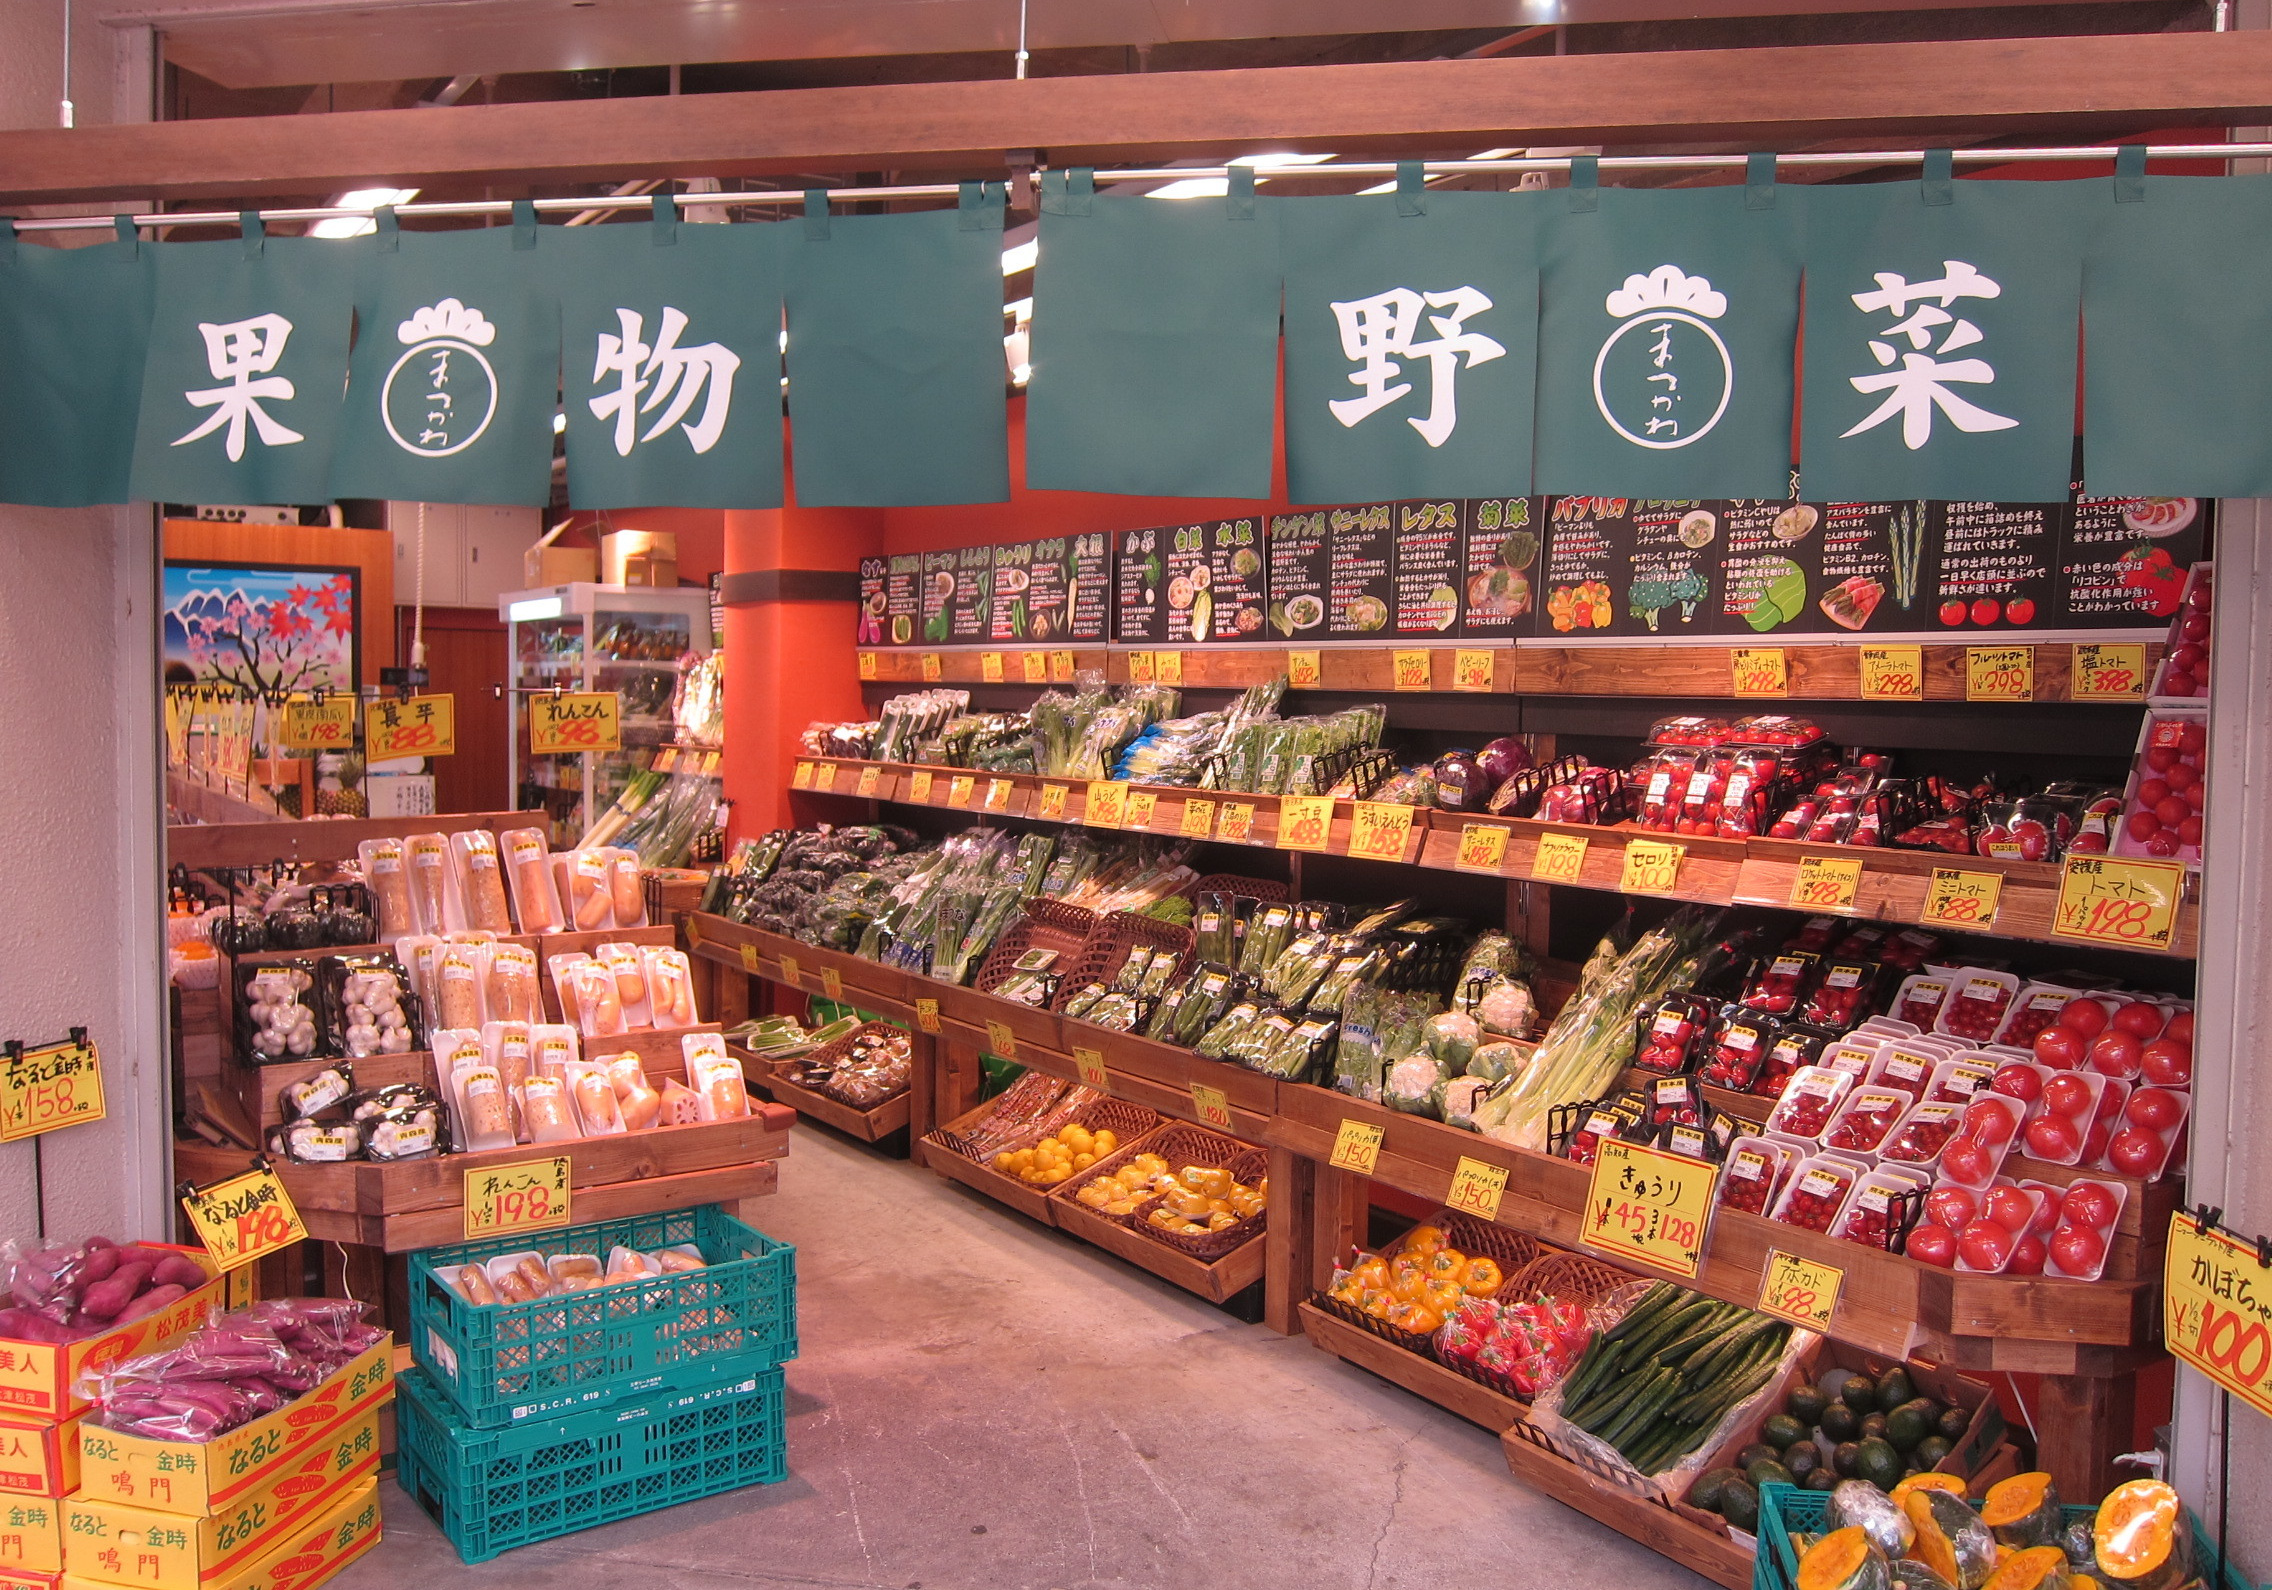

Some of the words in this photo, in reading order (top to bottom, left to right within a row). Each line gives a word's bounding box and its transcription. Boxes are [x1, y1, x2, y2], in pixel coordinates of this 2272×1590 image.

[1328, 286, 1506, 448] 野
[1838, 260, 2020, 450] 菜
[170, 313, 304, 462] 果
[588, 306, 741, 456] 物
[1645, 322, 1679, 436] まつかわ
[419, 350, 454, 446] まつかわ
[1401, 502, 1457, 531] レタス
[1477, 497, 1530, 530] 菊菜
[1074, 533, 1104, 558] 大根
[1126, 530, 1156, 554] かぶ
[1174, 525, 1203, 552] 白菜
[1215, 519, 1254, 547] 水菜
[2072, 560, 2144, 574] 赤い色の成分は
[1869, 660, 1913, 672] アメーラトマト
[2081, 655, 2127, 670] 塩トマト
[1468, 669, 1484, 687] 98
[1747, 671, 1777, 692] 298
[1878, 673, 1914, 695] 298
[1985, 669, 2025, 694] 398
[2093, 669, 2134, 692] 398
[546, 701, 609, 721] れんこん
[310, 723, 340, 741] 198
[390, 723, 436, 750] 88
[557, 718, 600, 746] 98
[1190, 814, 1207, 833] 198
[1289, 806, 1322, 822] 一寸豆
[1361, 811, 1408, 830] うすいえんどう
[1366, 827, 1403, 856] 158
[1467, 845, 1492, 866] 158
[1546, 853, 1579, 876] 198
[1632, 852, 1668, 868] セロリ
[1639, 867, 1671, 890] 100
[1938, 881, 1986, 896] ミニトマト
[2090, 875, 2146, 899] トマト
[1810, 881, 1841, 904] 98
[1942, 897, 1980, 920] 88
[2085, 898, 2152, 939] 198
[5, 1054, 82, 1090] なると金時
[25, 1077, 75, 1125] 158
[1344, 1142, 1371, 1164] 150
[1604, 1144, 1630, 1160] 高知産
[482, 1173, 541, 1197] れんこん
[1460, 1181, 1492, 1208] 150
[1619, 1165, 1682, 1207] きゅうり
[203, 1183, 278, 1226] なると金時
[495, 1185, 549, 1225] 198
[235, 1204, 290, 1254] 198
[1614, 1202, 1646, 1233] 45
[1659, 1214, 1696, 1249] 128
[1780, 1264, 1827, 1290] アボカド
[2191, 1254, 2272, 1326] かぼちゃ
[1781, 1287, 1816, 1318] 98
[2195, 1298, 2272, 1388] 100
[350, 1357, 387, 1402] 金時
[540, 1397, 577, 1411] S.C.R.
[582, 1391, 600, 1401] 619
[84, 1436, 119, 1462] なると
[156, 1450, 197, 1475] 金時
[229, 1428, 281, 1476] なると
[335, 1426, 374, 1472] 金時
[8, 1504, 48, 1528] 金時
[217, 1502, 266, 1551] なると
[337, 1503, 375, 1550] 金時
[70, 1512, 108, 1538] なると
[147, 1525, 188, 1551] 金時
